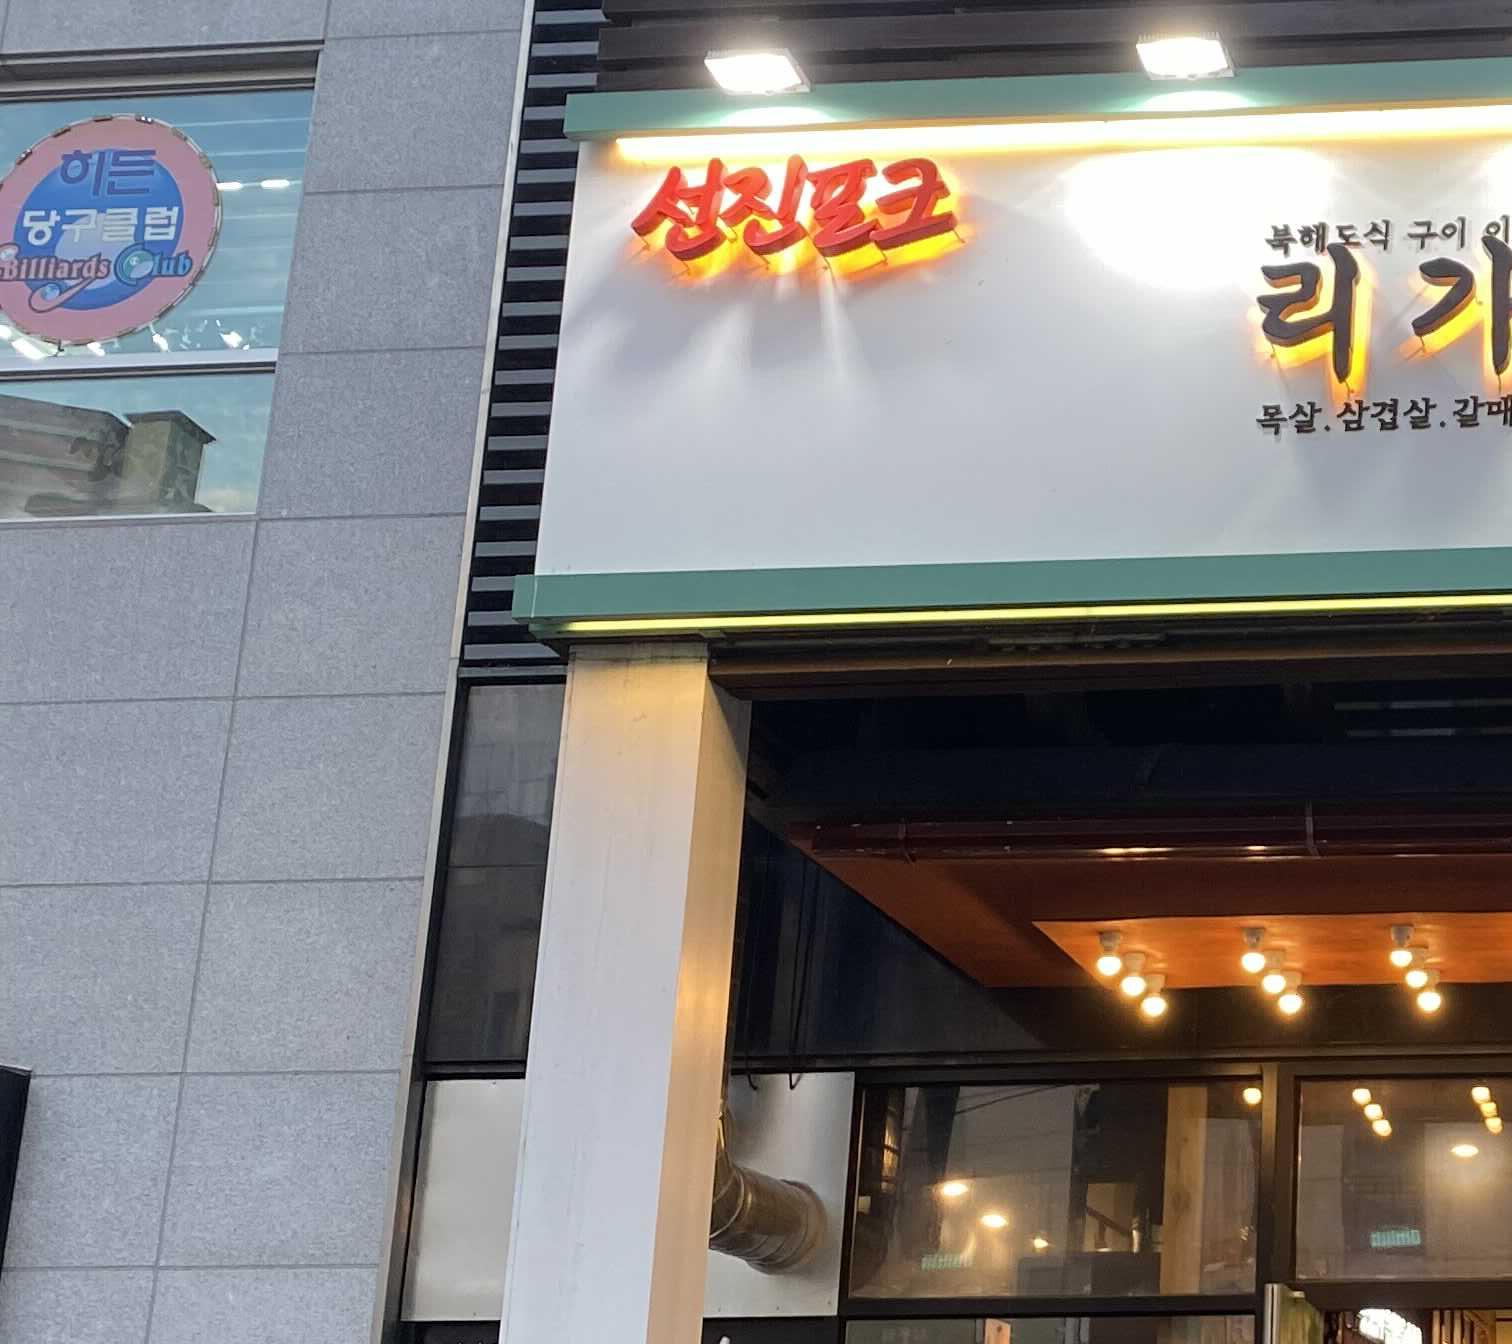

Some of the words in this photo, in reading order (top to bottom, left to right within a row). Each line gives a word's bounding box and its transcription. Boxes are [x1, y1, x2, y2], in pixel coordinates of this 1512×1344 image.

[60, 149, 156, 197] 히든
[23, 207, 180, 246] 당구클럽
[1265, 219, 1391, 256] 북해도식
[1407, 216, 1466, 248] 구이
